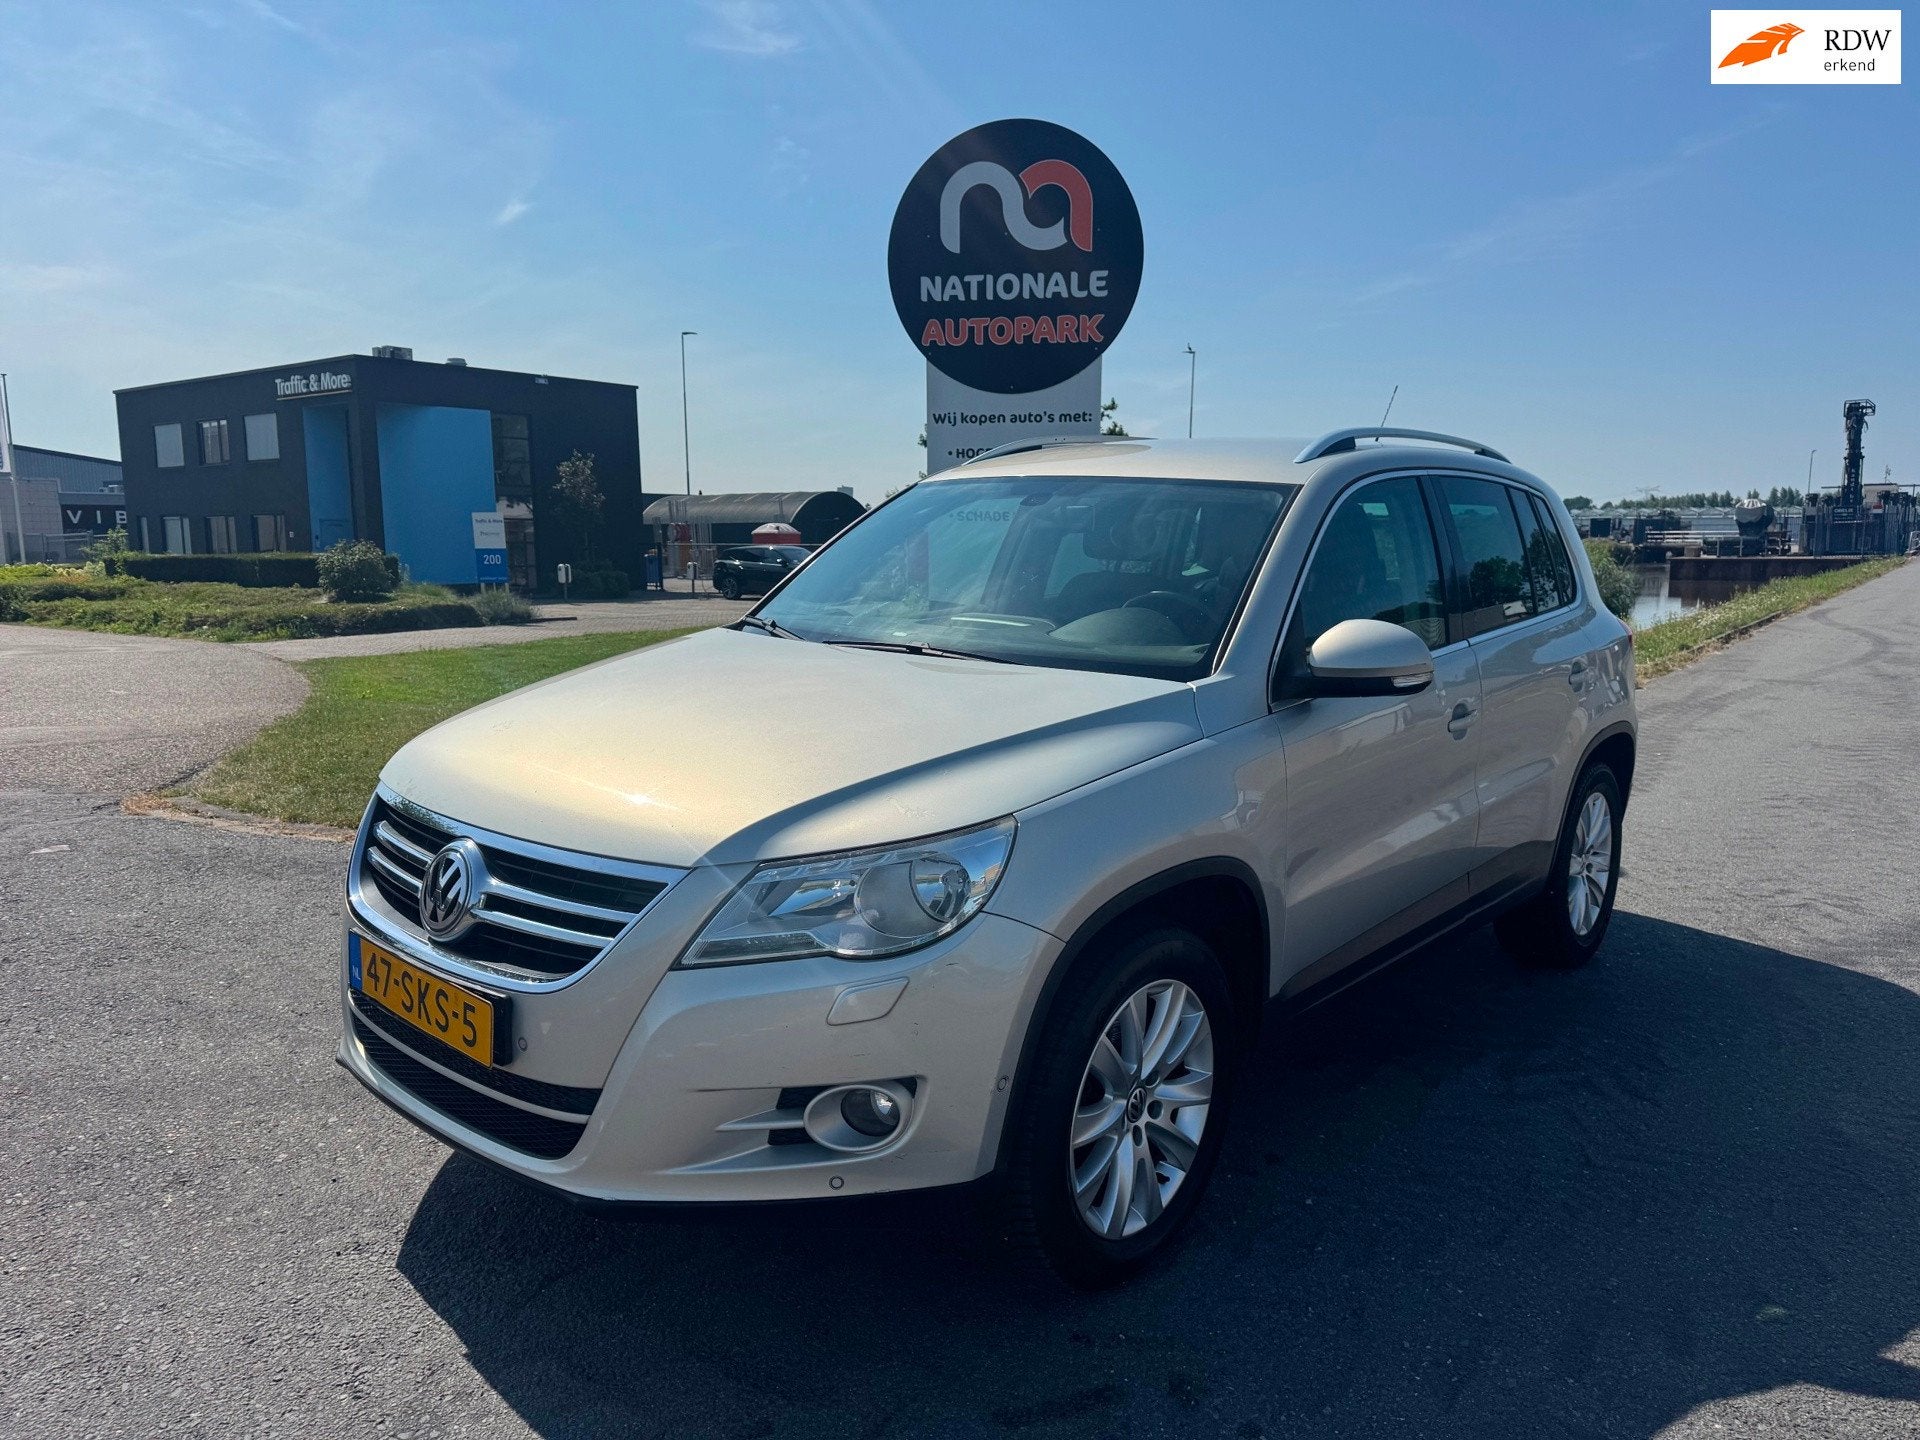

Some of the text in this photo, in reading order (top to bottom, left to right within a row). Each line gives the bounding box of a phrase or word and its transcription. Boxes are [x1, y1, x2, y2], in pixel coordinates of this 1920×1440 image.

[920, 269, 1109, 302] NATIONALE
[921, 314, 1105, 347] AUTOPARK
[275, 374, 308, 396] Traffic
[309, 373, 320, 392] &
[932, 410, 1093, 427] Wij kopen auto's met:
[956, 447, 993, 459] HO
[483, 554, 502, 565] 200
[352, 965, 362, 980] NL
[366, 952, 478, 1049] 47-SKS-5
